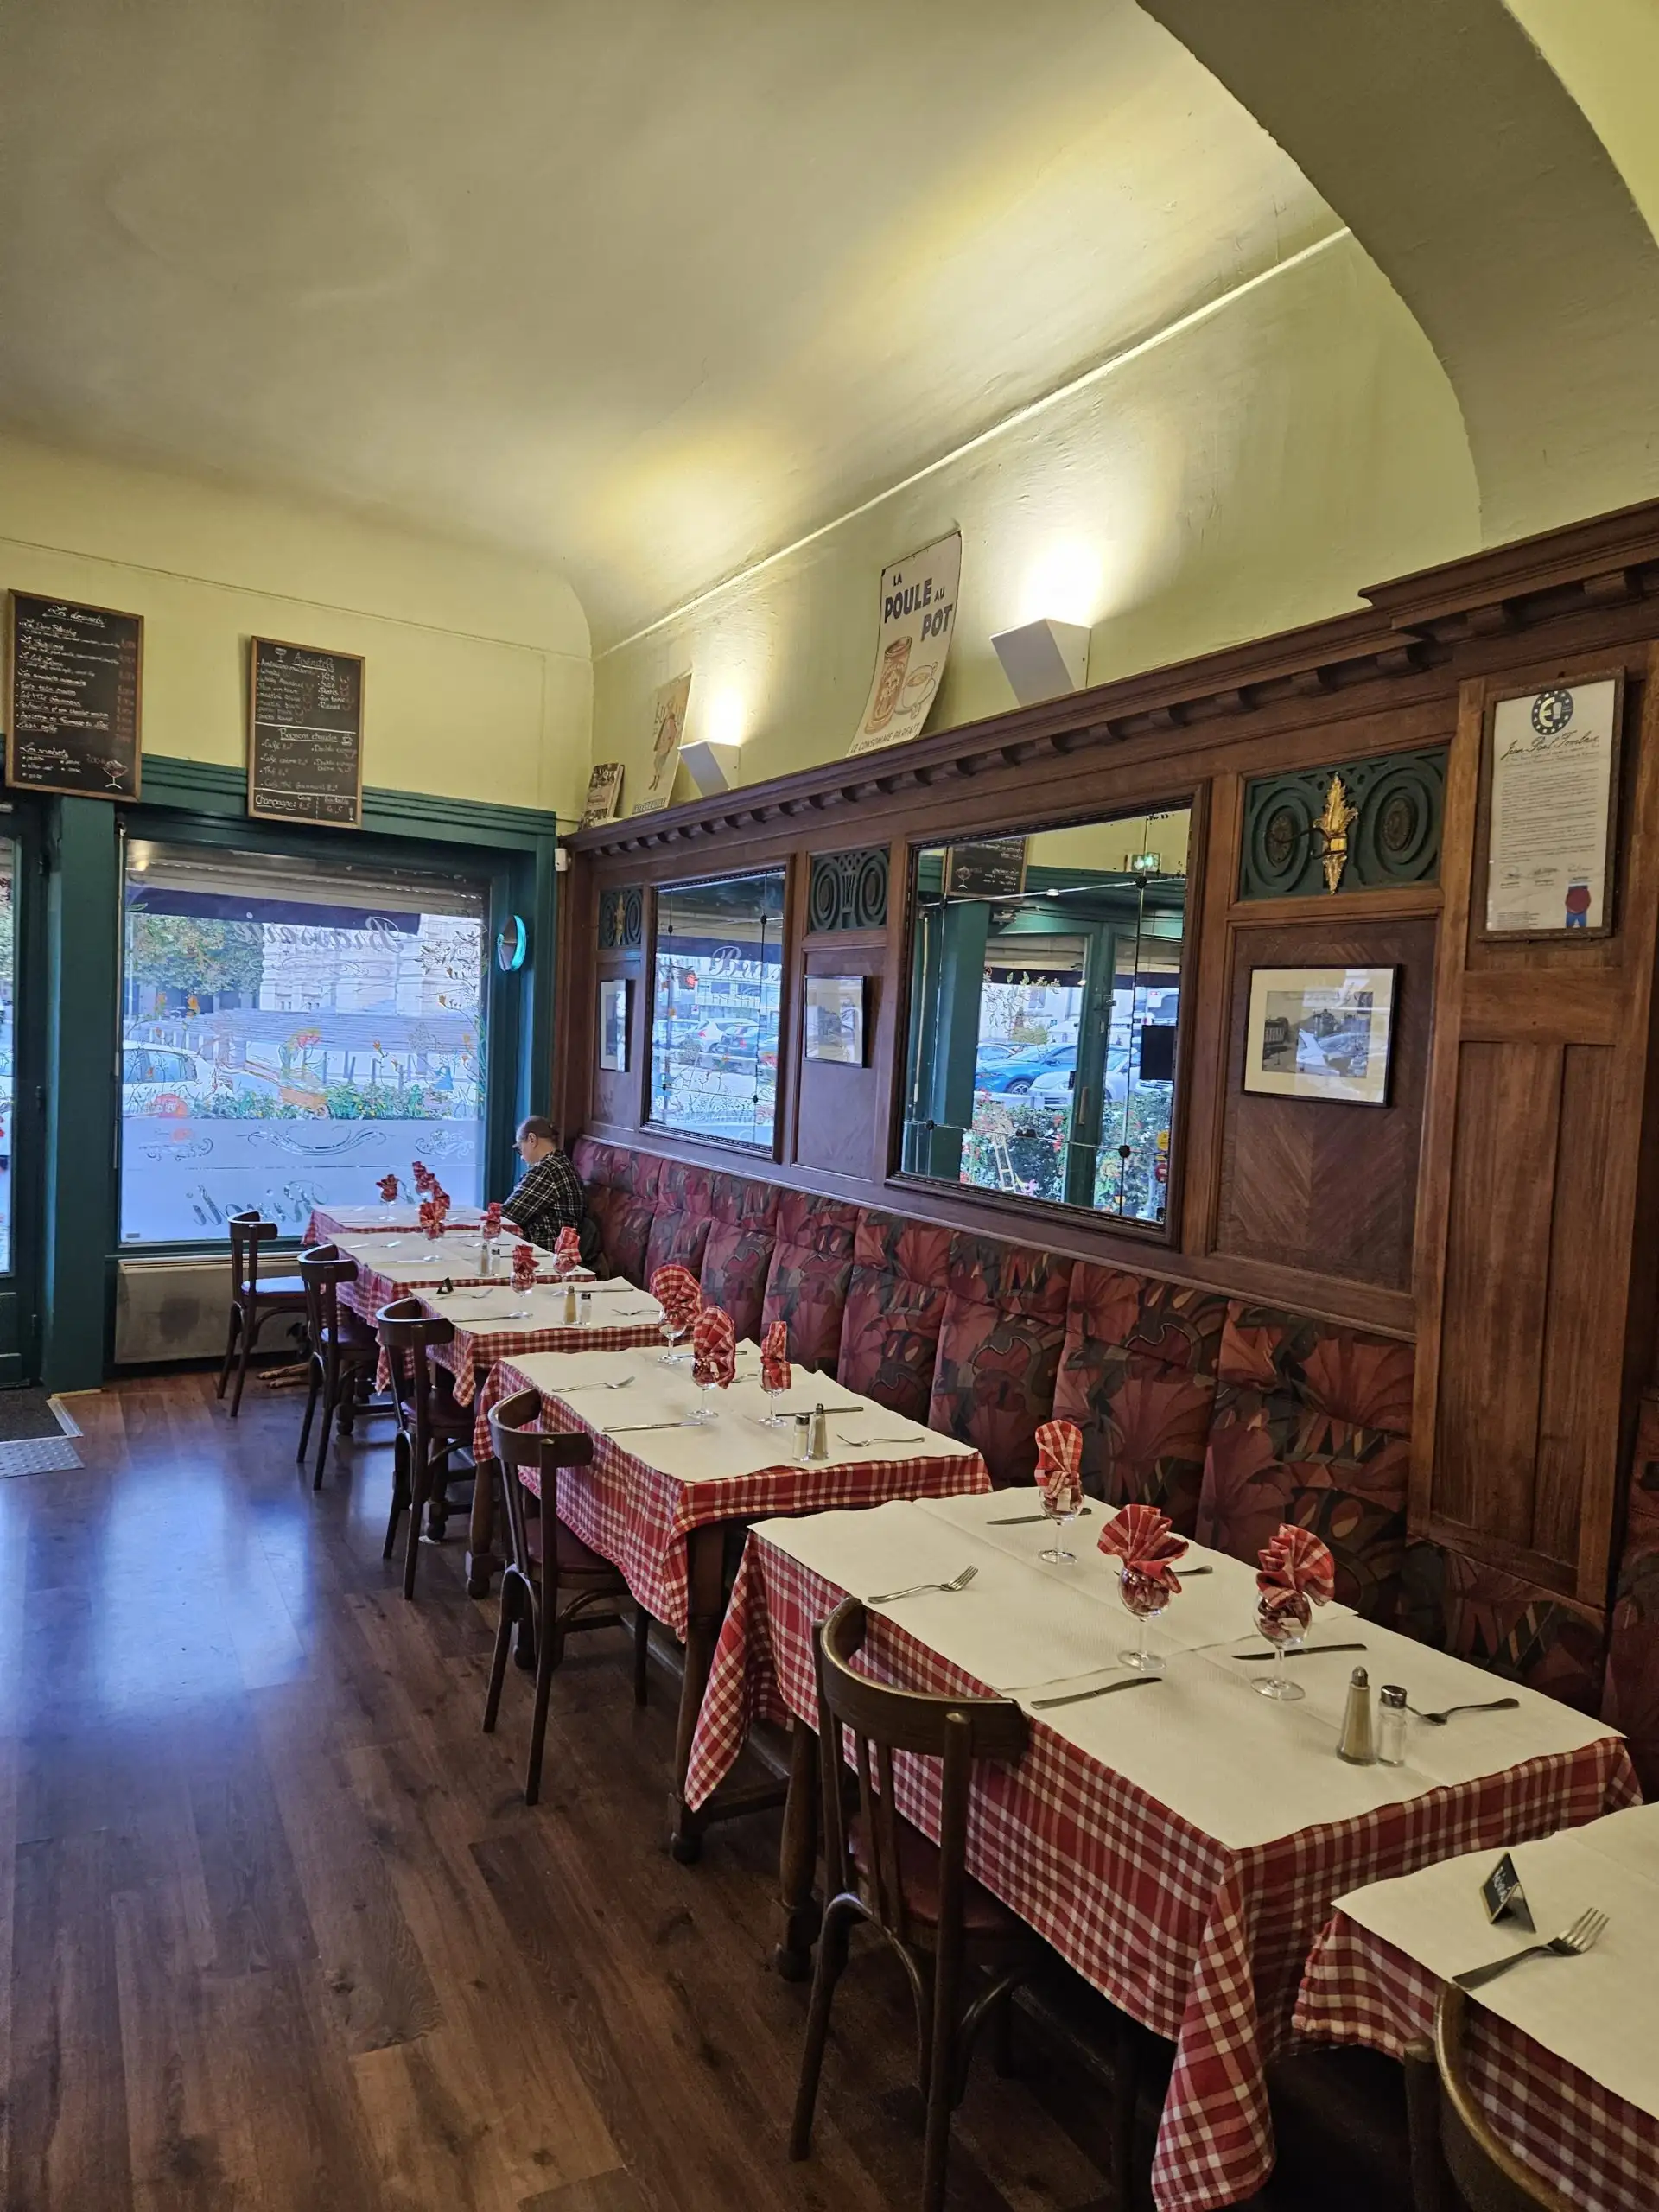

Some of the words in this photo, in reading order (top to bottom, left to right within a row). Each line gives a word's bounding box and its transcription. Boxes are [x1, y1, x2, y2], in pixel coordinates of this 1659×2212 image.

[893, 572, 903, 587] LA
[884, 577, 933, 624] POULE
[933, 587, 946, 603] AU
[920, 603, 955, 642] POT
